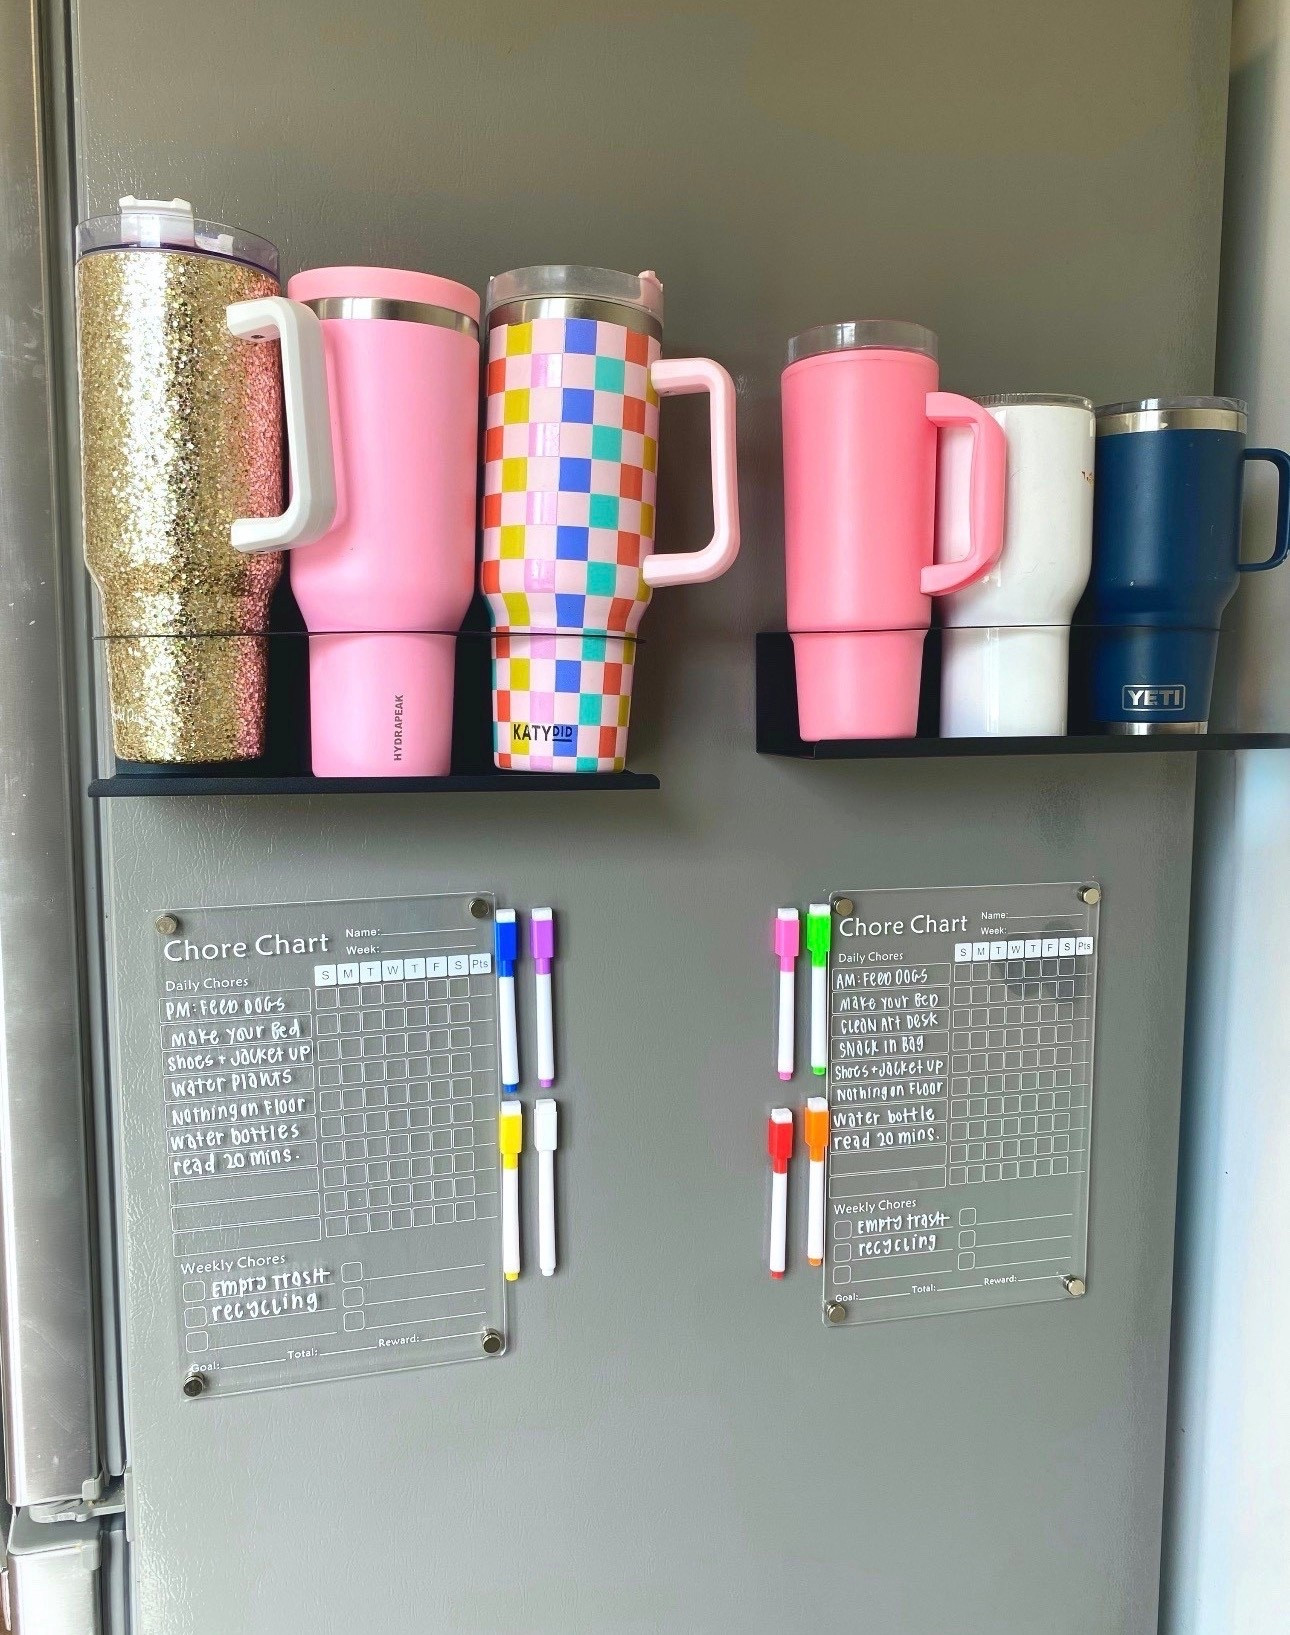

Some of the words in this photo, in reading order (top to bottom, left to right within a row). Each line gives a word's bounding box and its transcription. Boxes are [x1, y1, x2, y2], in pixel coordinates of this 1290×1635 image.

[1127, 690, 1180, 706] YETI
[394, 695, 404, 761] HYDRAPEAK
[981, 912, 1008, 920] Name:
[345, 928, 381, 938] Name:
[840, 918, 904, 937] Chore
[910, 915, 968, 934] Chart
[981, 927, 1007, 935] Week:
[164, 939, 247, 962] Chore
[255, 934, 329, 956] Chart
[346, 945, 380, 955] Week:
[961, 948, 967, 956] S
[996, 946, 1002, 954] T
[1011, 945, 1020, 953] W
[1064, 942, 1070, 950] S
[1078, 941, 1091, 950] Pts
[838, 953, 866, 964] Daily
[868, 952, 904, 961] Chores
[321, 971, 330, 980] S
[343, 969, 353, 978] M
[367, 968, 375, 977] T
[387, 966, 399, 975] W
[411, 964, 419, 973] T
[433, 963, 440, 972] F
[455, 960, 463, 970] S
[472, 959, 489, 969] Pts
[166, 980, 200, 992] Daily
[203, 977, 249, 989] Chores
[836, 973, 860, 989] AM:
[218, 1054, 226, 1065] +
[871, 1066, 878, 1075] +
[887, 1105, 935, 1124] bottle
[230, 1123, 300, 1145] bottles
[834, 1131, 870, 1150] read
[877, 1131, 894, 1147] 20
[898, 1127, 940, 1145] mins.
[173, 1152, 215, 1175] read
[223, 1153, 245, 1169] 20
[250, 1148, 300, 1166] mins.
[834, 1201, 876, 1214] Weekly
[878, 1200, 917, 1211] Chores
[859, 1234, 936, 1256] recycling
[181, 1259, 233, 1275] Weekly
[237, 1254, 286, 1269] Chores
[835, 1293, 858, 1302] Goal:
[912, 1284, 936, 1293] Total:
[984, 1275, 1017, 1285] Reward:
[212, 1292, 318, 1322] recycling
[190, 1361, 220, 1372] Goal:
[287, 1348, 318, 1359] Total:
[378, 1334, 420, 1348] Reward:
